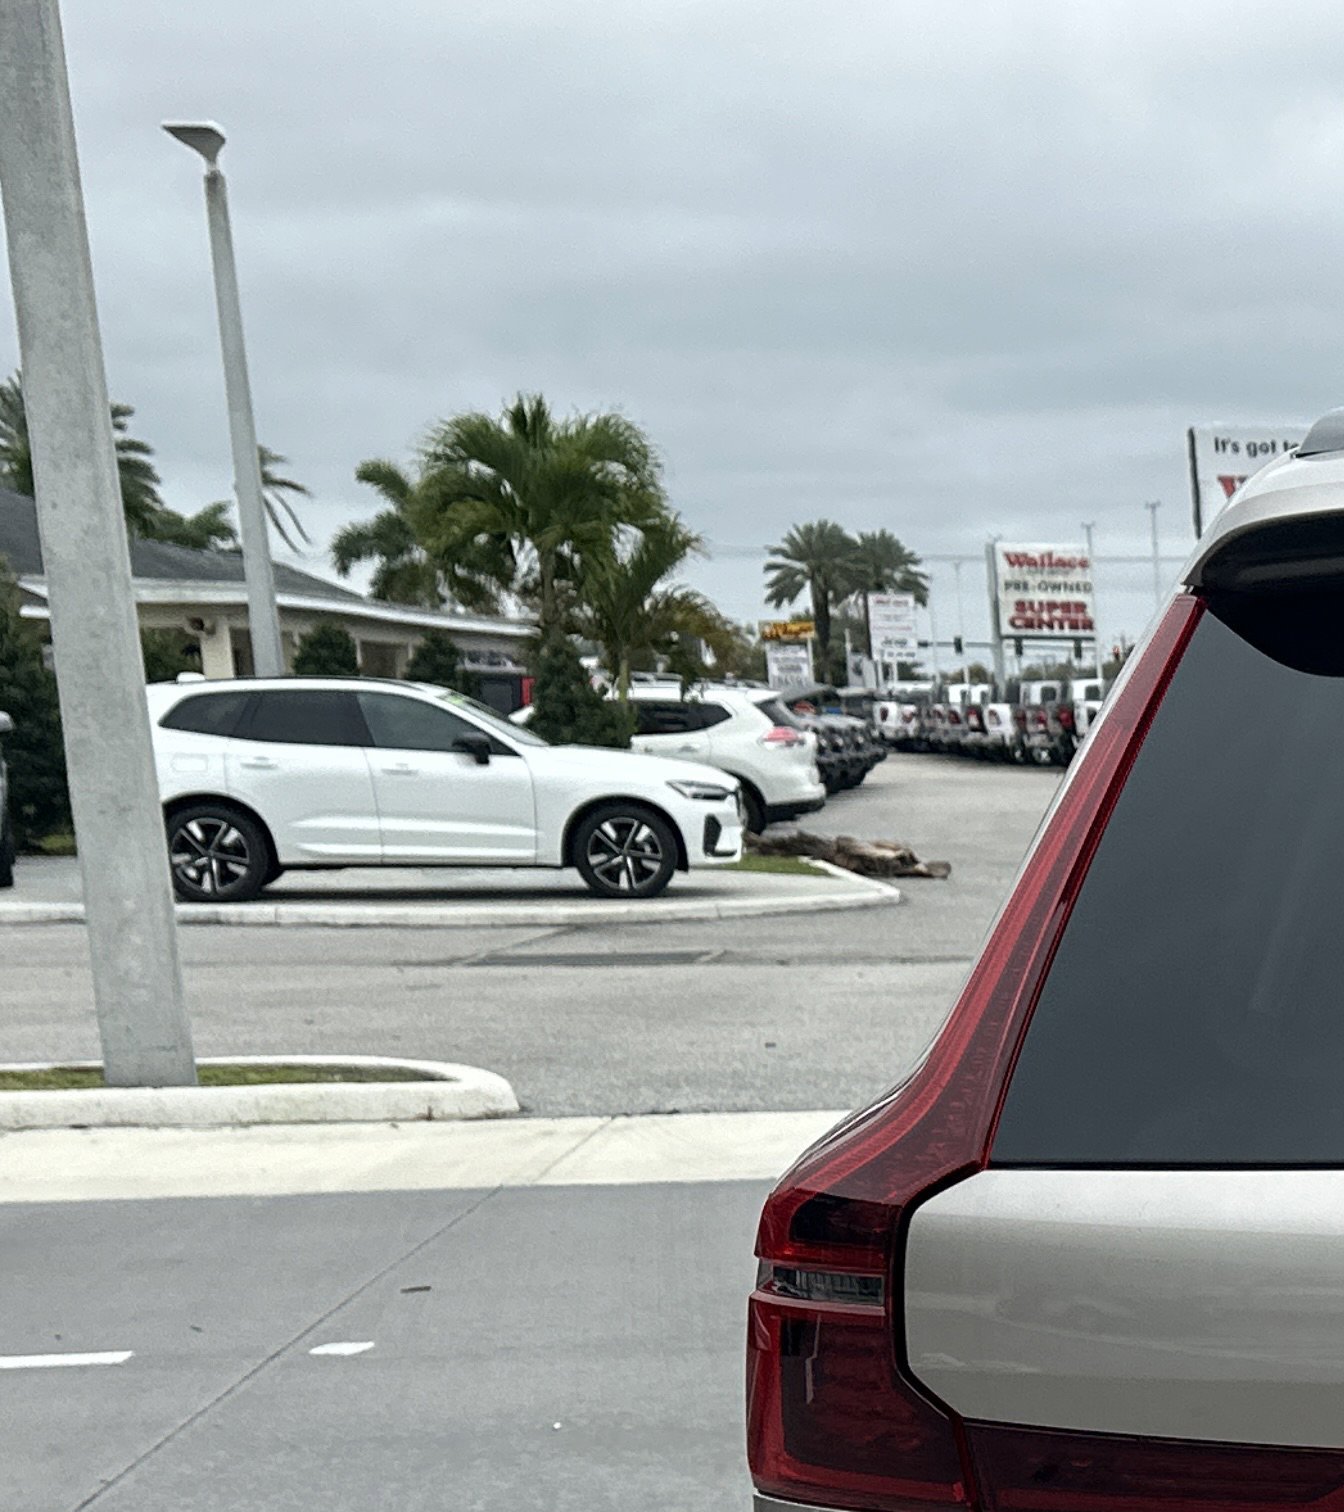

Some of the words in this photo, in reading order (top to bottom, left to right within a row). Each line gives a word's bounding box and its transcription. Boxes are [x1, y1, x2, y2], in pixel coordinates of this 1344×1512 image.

[1214, 436, 1240, 455] It's
[1246, 439, 1276, 459] got
[1002, 551, 1090, 569] Wallace
[1014, 599, 1087, 614] SUPER
[1008, 616, 1094, 631] CENTER
